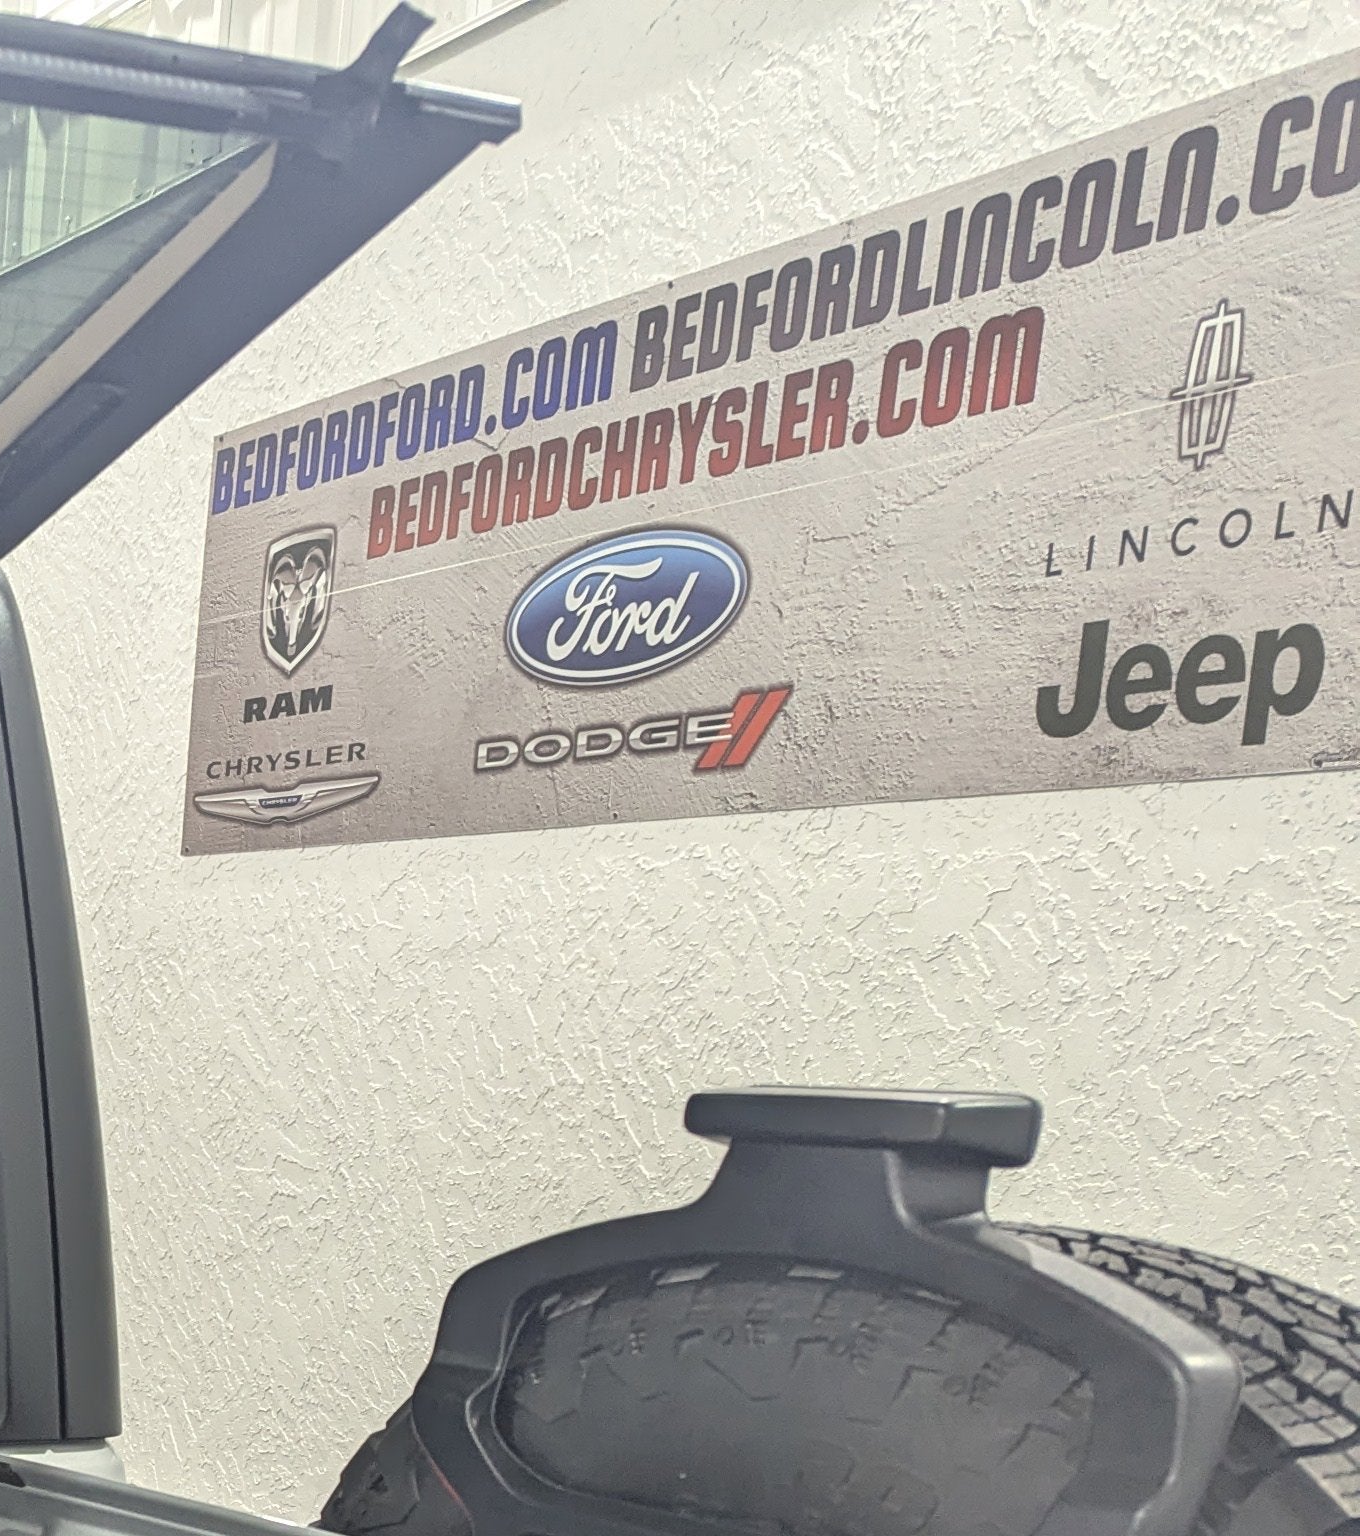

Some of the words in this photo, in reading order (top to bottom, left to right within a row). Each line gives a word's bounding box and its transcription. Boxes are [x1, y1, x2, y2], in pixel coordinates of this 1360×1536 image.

[212, 321, 618, 515] BEDFORDFORD.COM
[367, 306, 1044, 559] BEDFORDCHRYSLER.COM
[1045, 489, 1355, 577] LINCOLN
[546, 556, 700, 661] Ford
[243, 684, 334, 724] RAM
[1035, 619, 1325, 746] Jeep
[206, 742, 366, 779] CHRYSLER
[475, 711, 734, 770] DODGE
